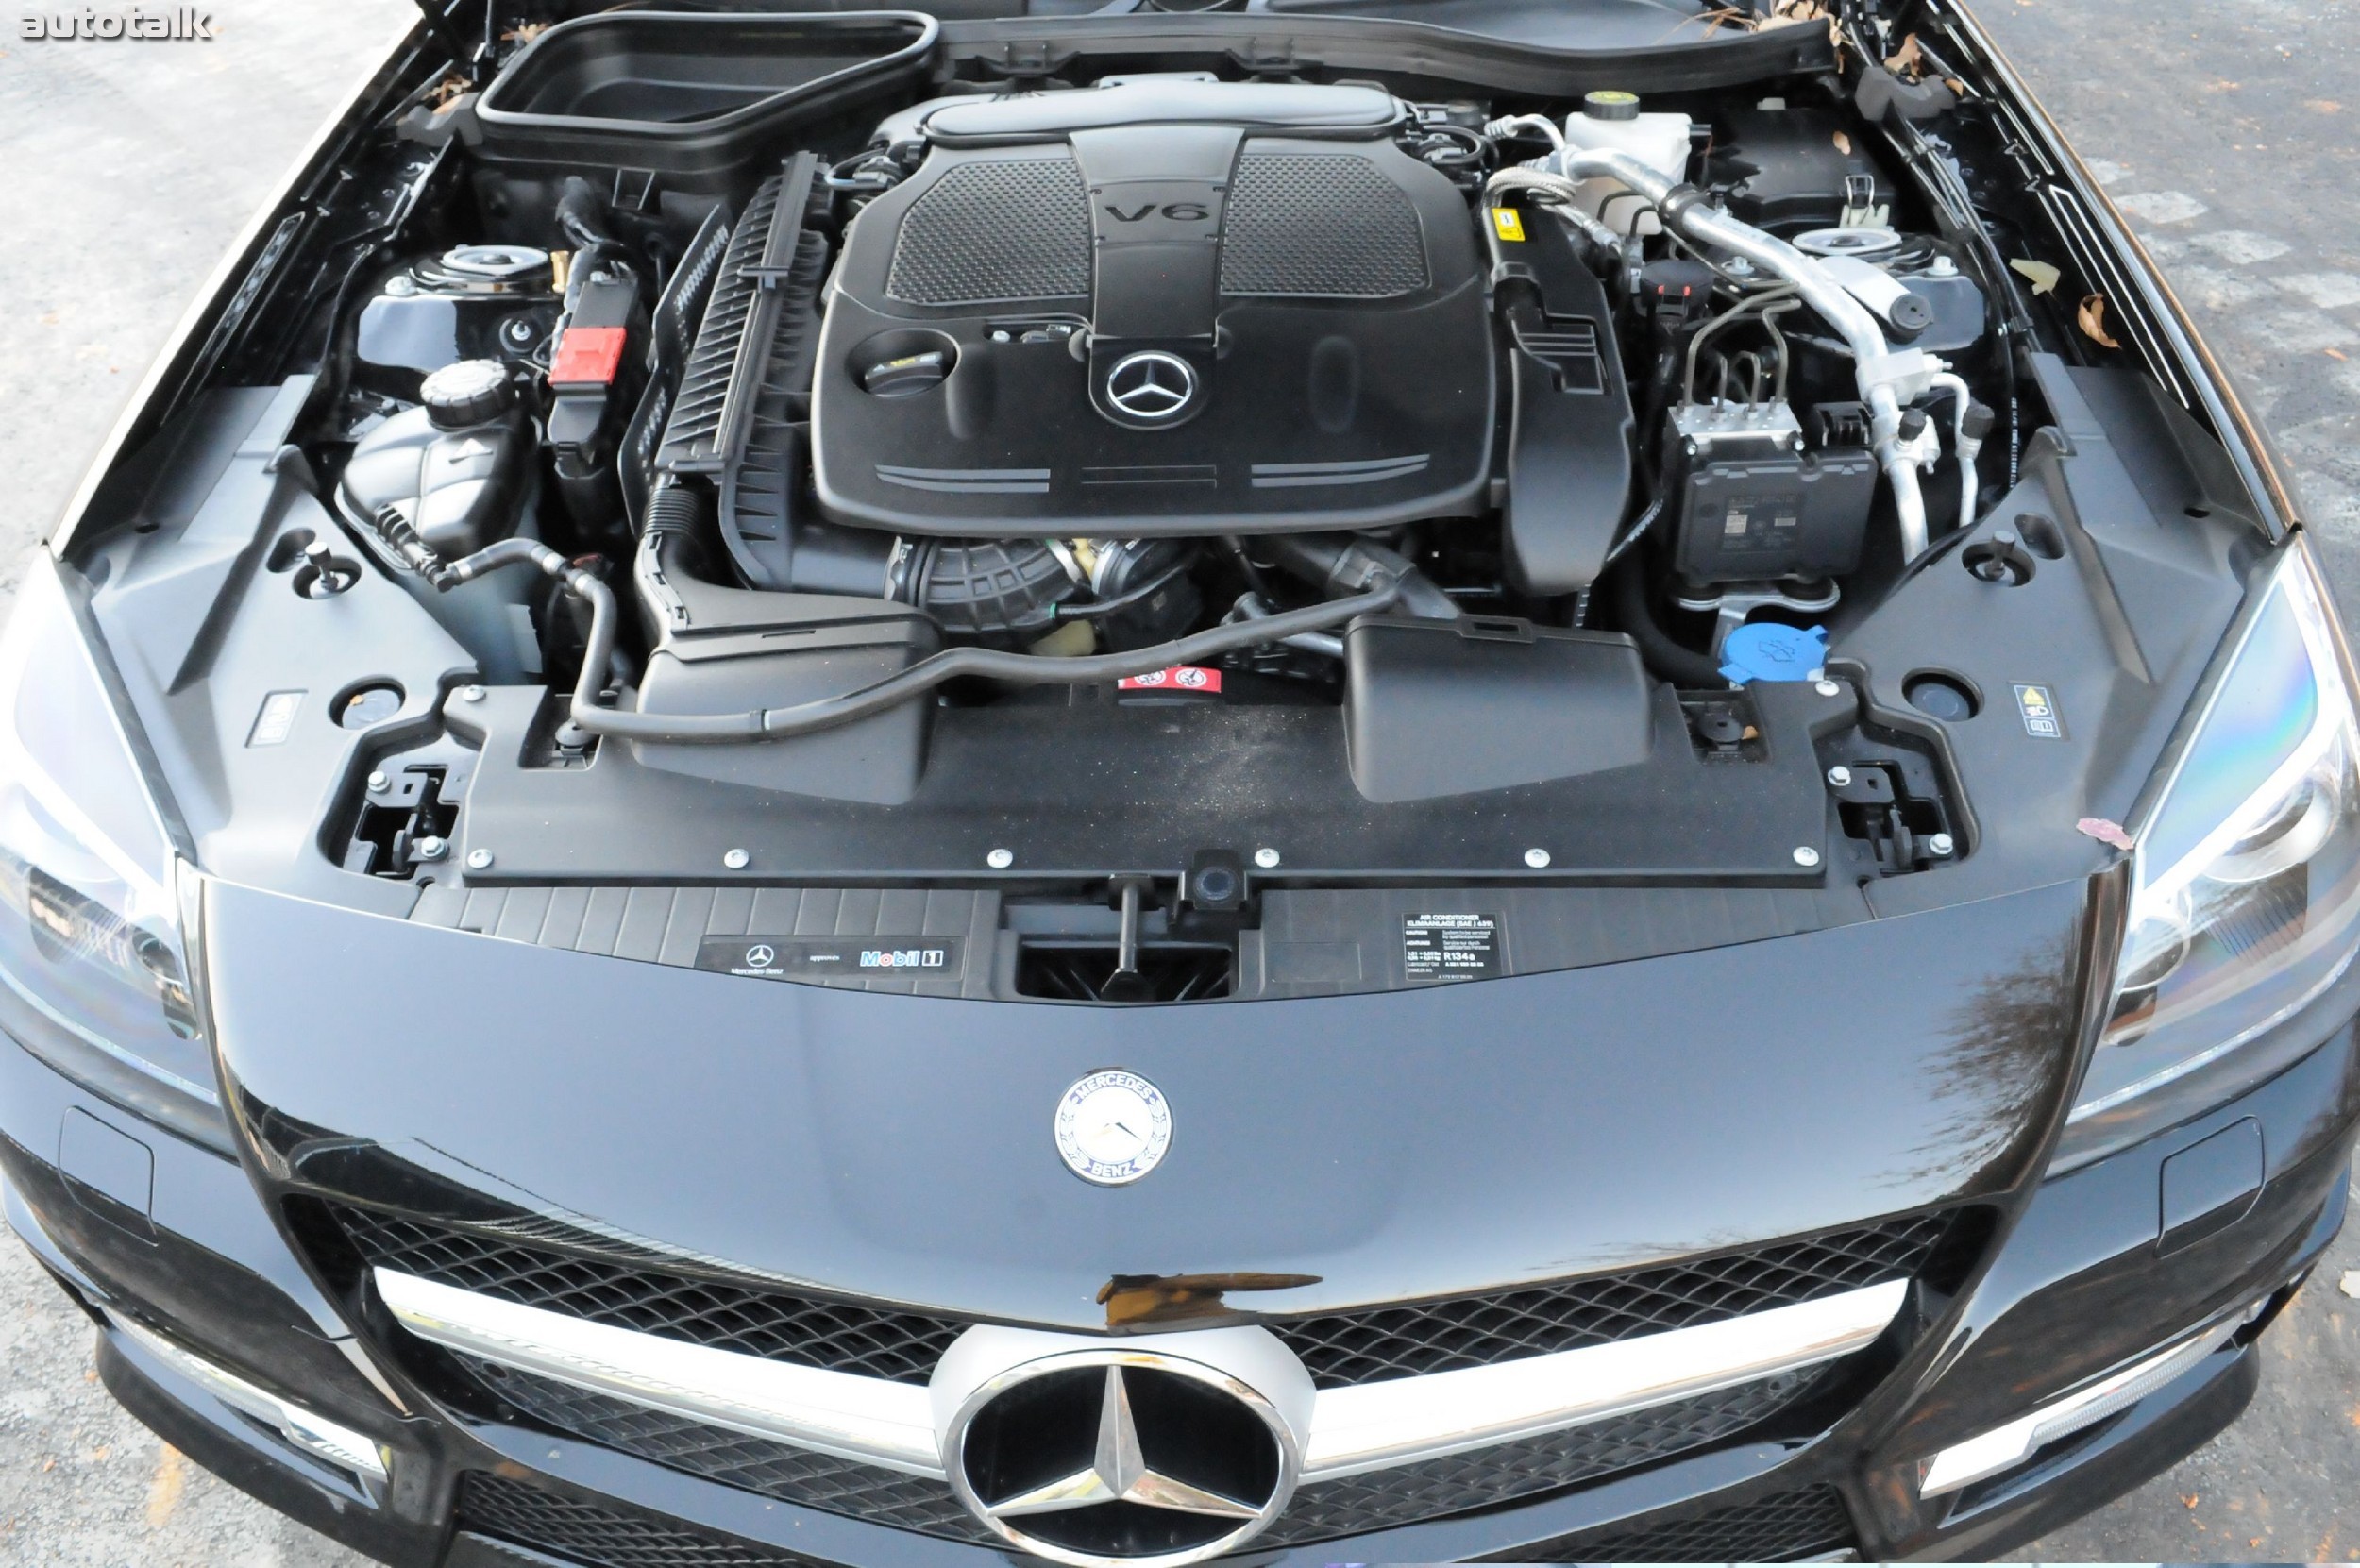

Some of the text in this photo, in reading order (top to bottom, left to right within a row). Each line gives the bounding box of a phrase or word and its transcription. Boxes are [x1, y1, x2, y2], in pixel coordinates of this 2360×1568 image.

[1104, 203, 1209, 222] V6
[860, 951, 920, 967] Mobil
[1443, 952, 1475, 961] R134a
[1075, 1074, 1153, 1099] MERCEDES
[1090, 1162, 1134, 1177] BENZ
